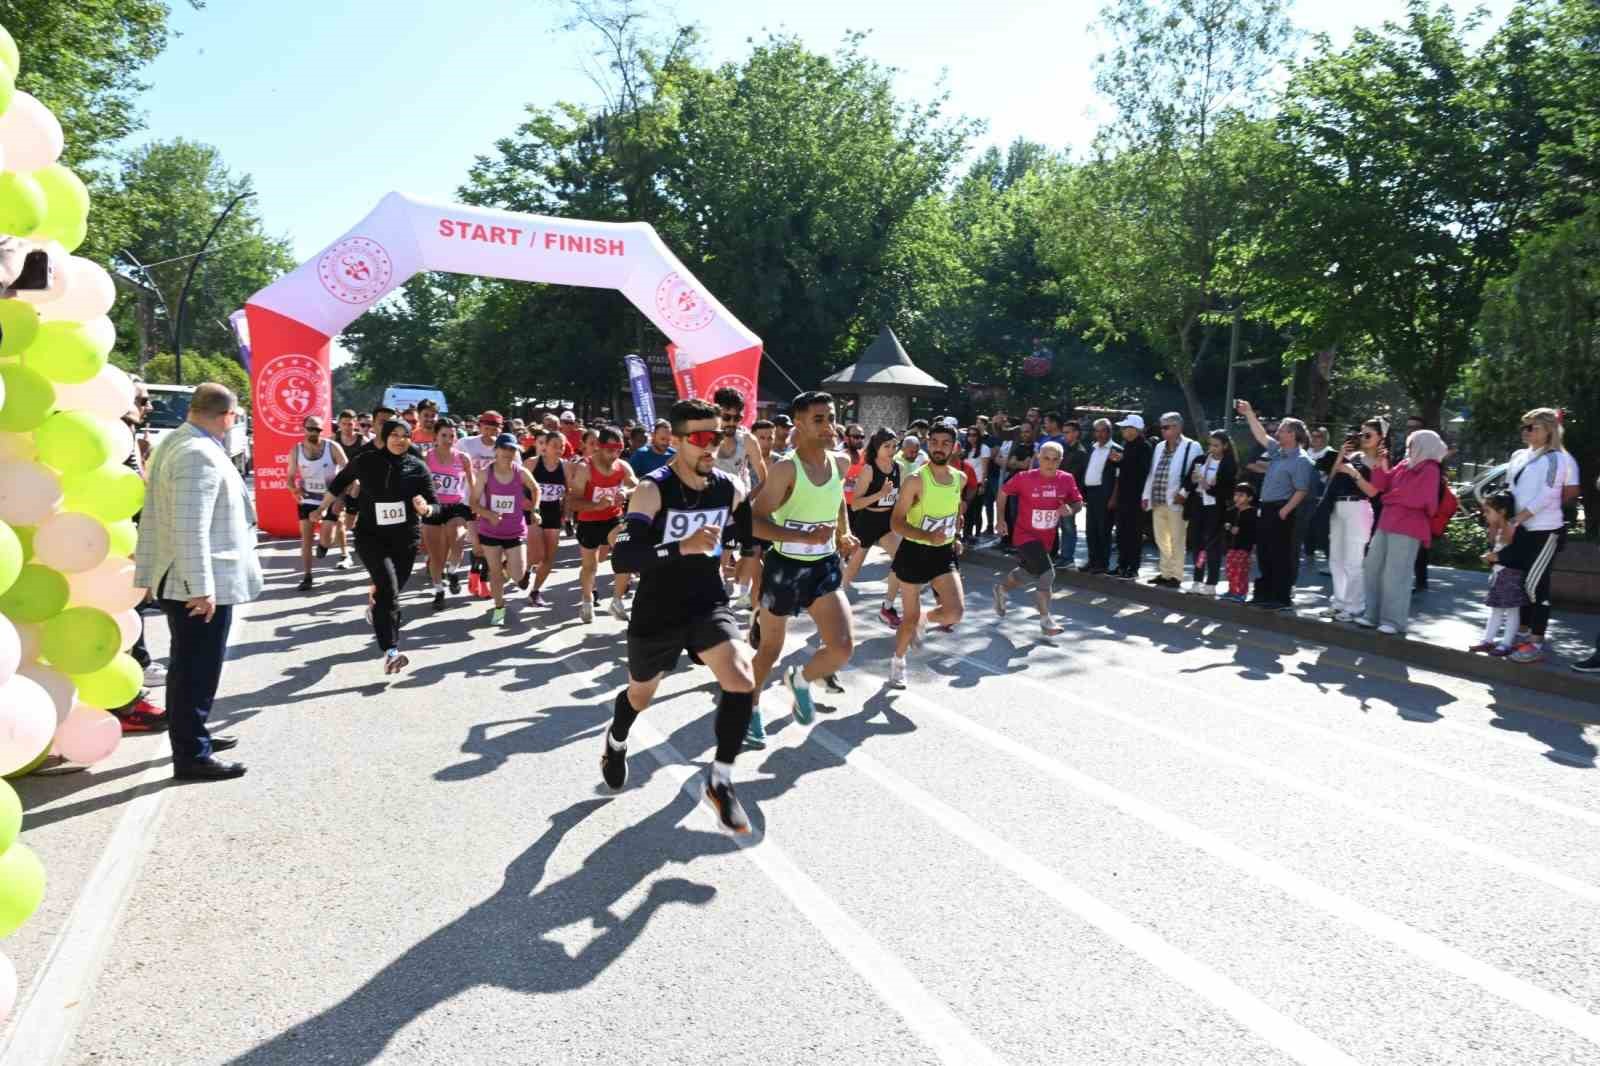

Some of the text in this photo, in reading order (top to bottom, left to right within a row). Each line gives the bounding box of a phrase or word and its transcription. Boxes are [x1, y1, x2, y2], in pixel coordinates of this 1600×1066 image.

[439, 219, 522, 246] START
[544, 233, 625, 256] FINISH
[495, 500, 513, 509] 107
[382, 508, 404, 519] 101
